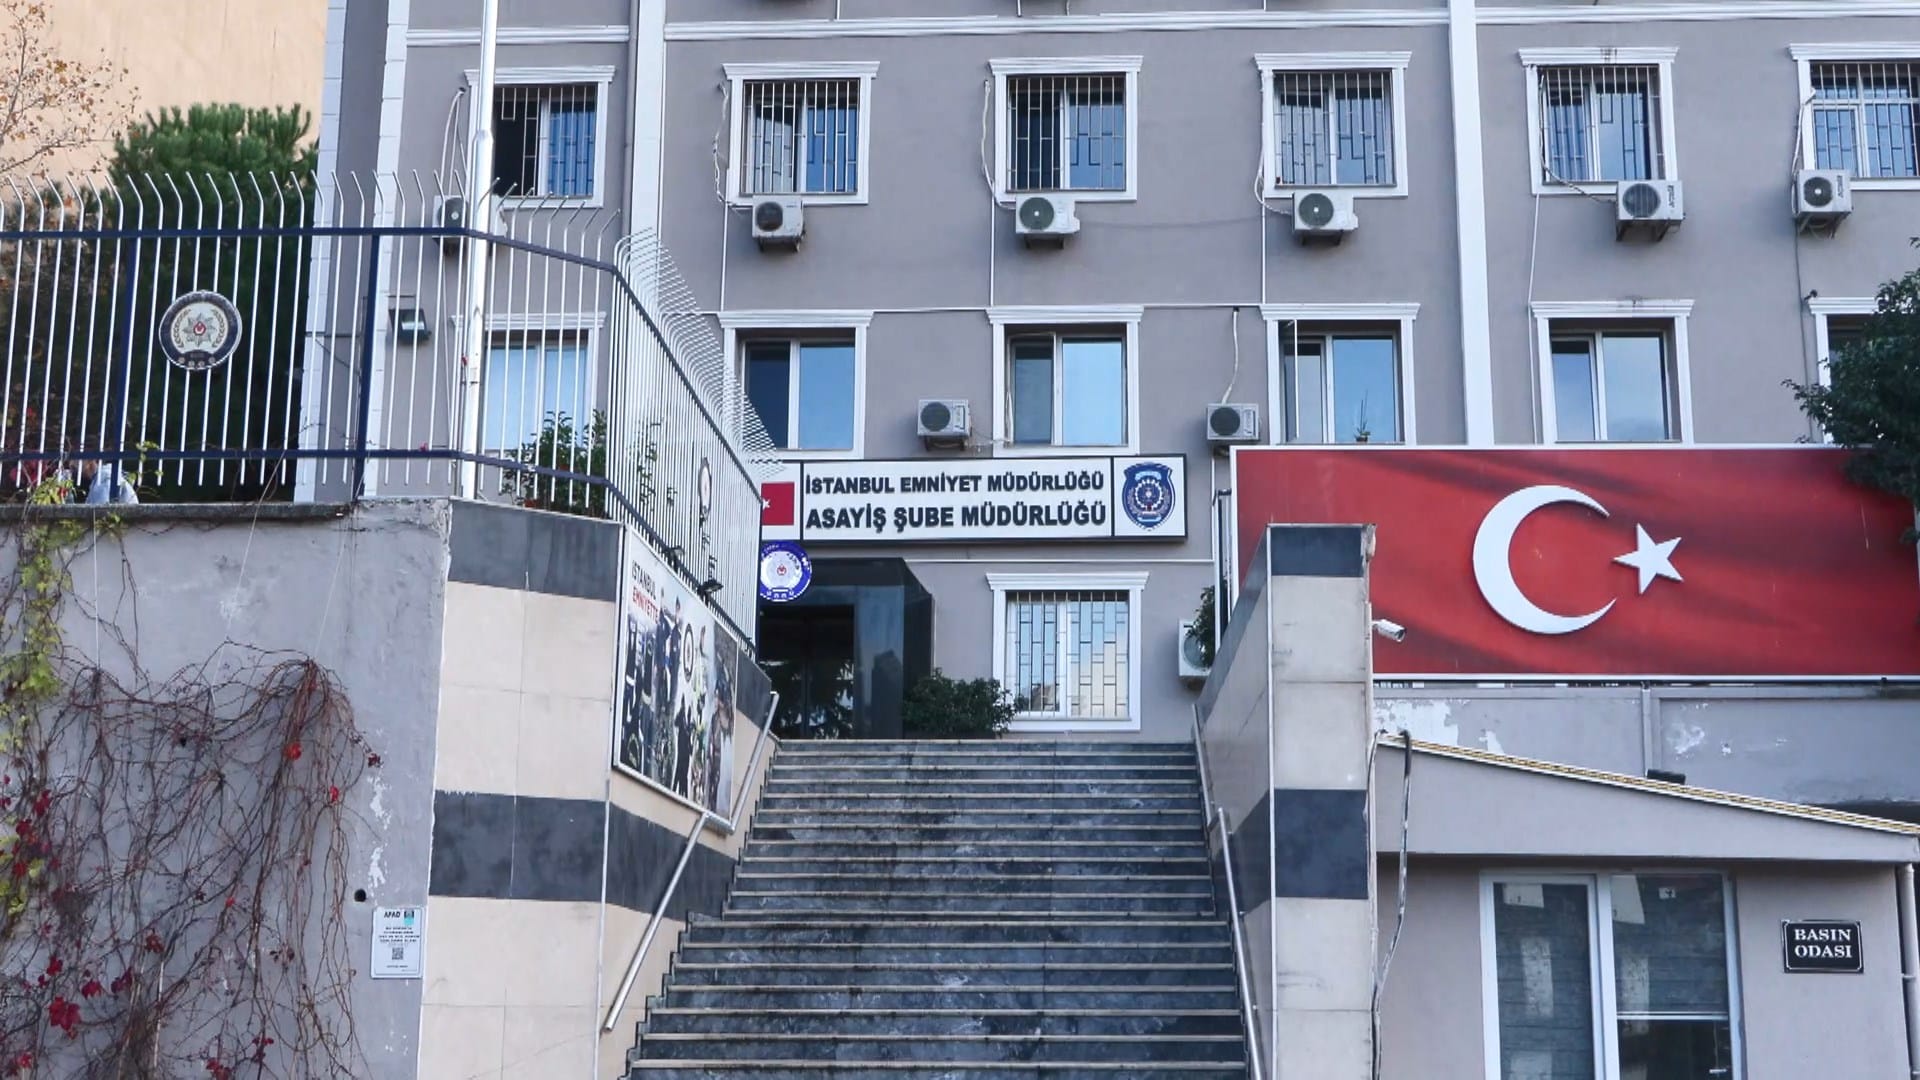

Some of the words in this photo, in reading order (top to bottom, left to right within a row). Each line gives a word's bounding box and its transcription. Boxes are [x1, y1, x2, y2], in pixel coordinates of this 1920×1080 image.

[805, 474, 895, 494] İSTANBUL
[900, 471, 982, 492] EMNİYET
[987, 471, 1104, 492] MÜDÜRLÜĞÜ
[805, 502, 887, 534] ASAYİŞ
[893, 506, 954, 533] ŞUBE
[961, 499, 1106, 526] MÜDÜRLÜĞÜ
[1794, 928, 1852, 941] BASIN
[1794, 945, 1853, 958] ODASI
